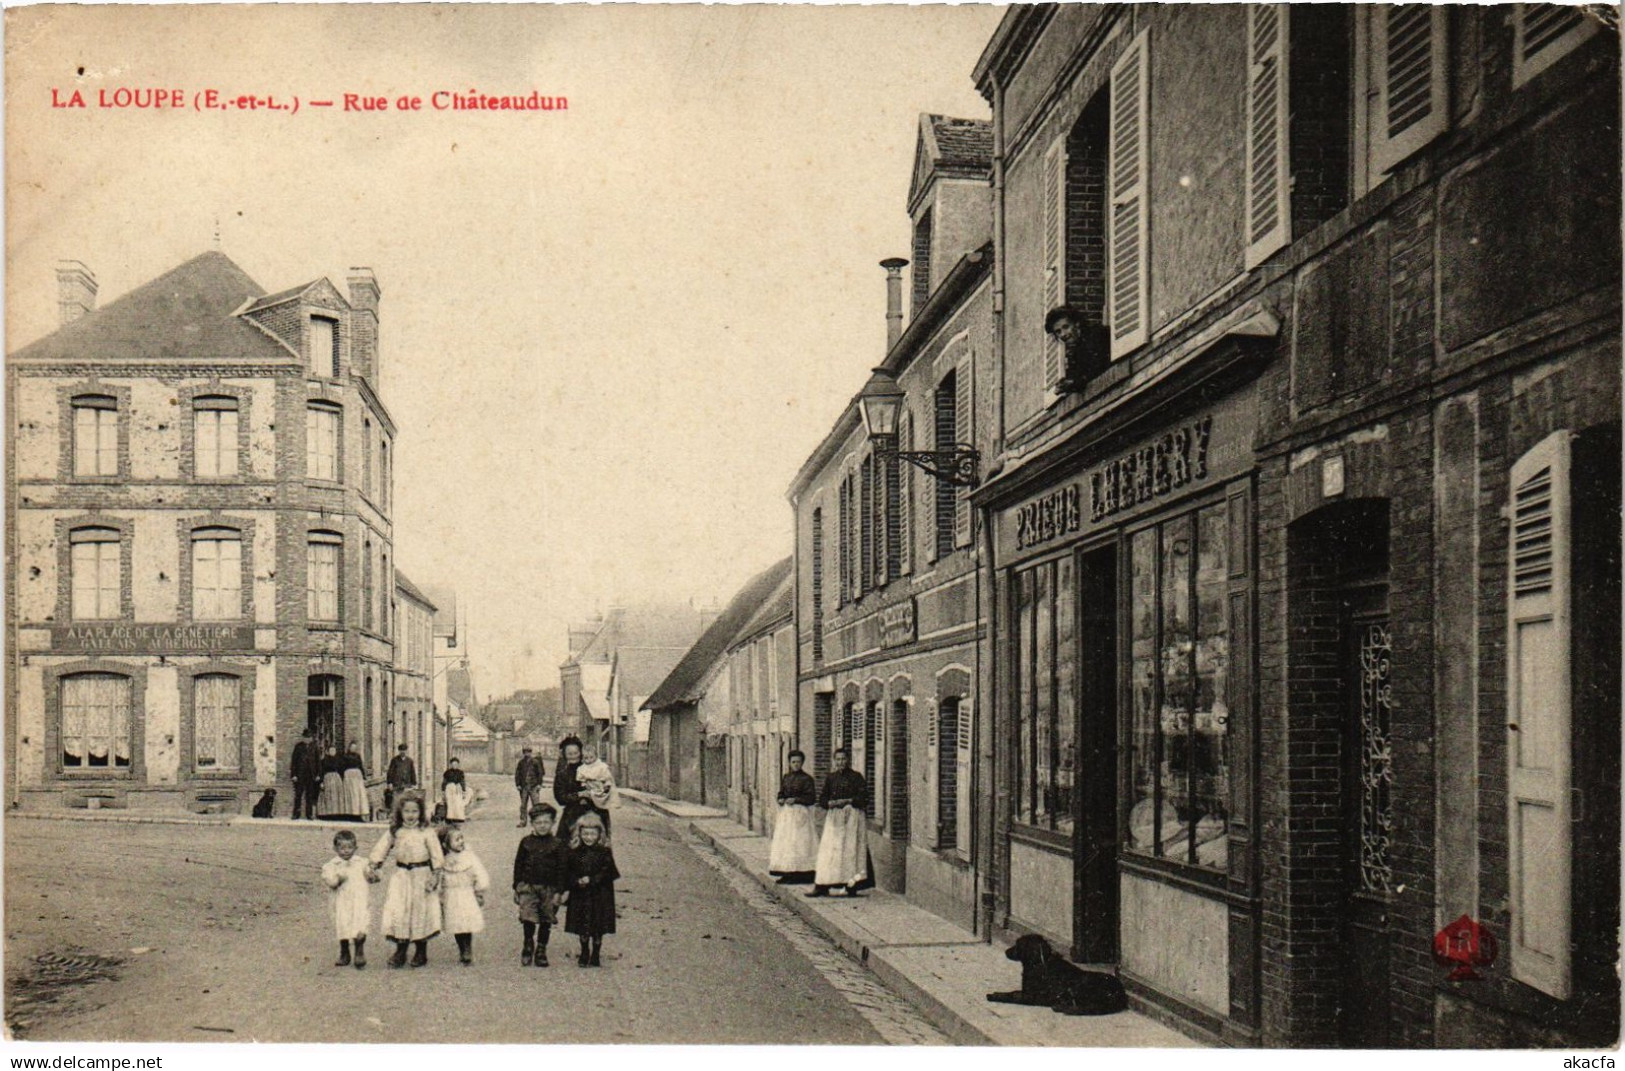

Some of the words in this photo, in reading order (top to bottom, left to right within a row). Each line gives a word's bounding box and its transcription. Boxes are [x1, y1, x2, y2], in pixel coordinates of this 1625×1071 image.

[1015, 484, 1081, 552] PRIEUR
[95, 627, 132, 639] PLACE
[135, 627, 150, 639] DE
[154, 627, 171, 639] LA
